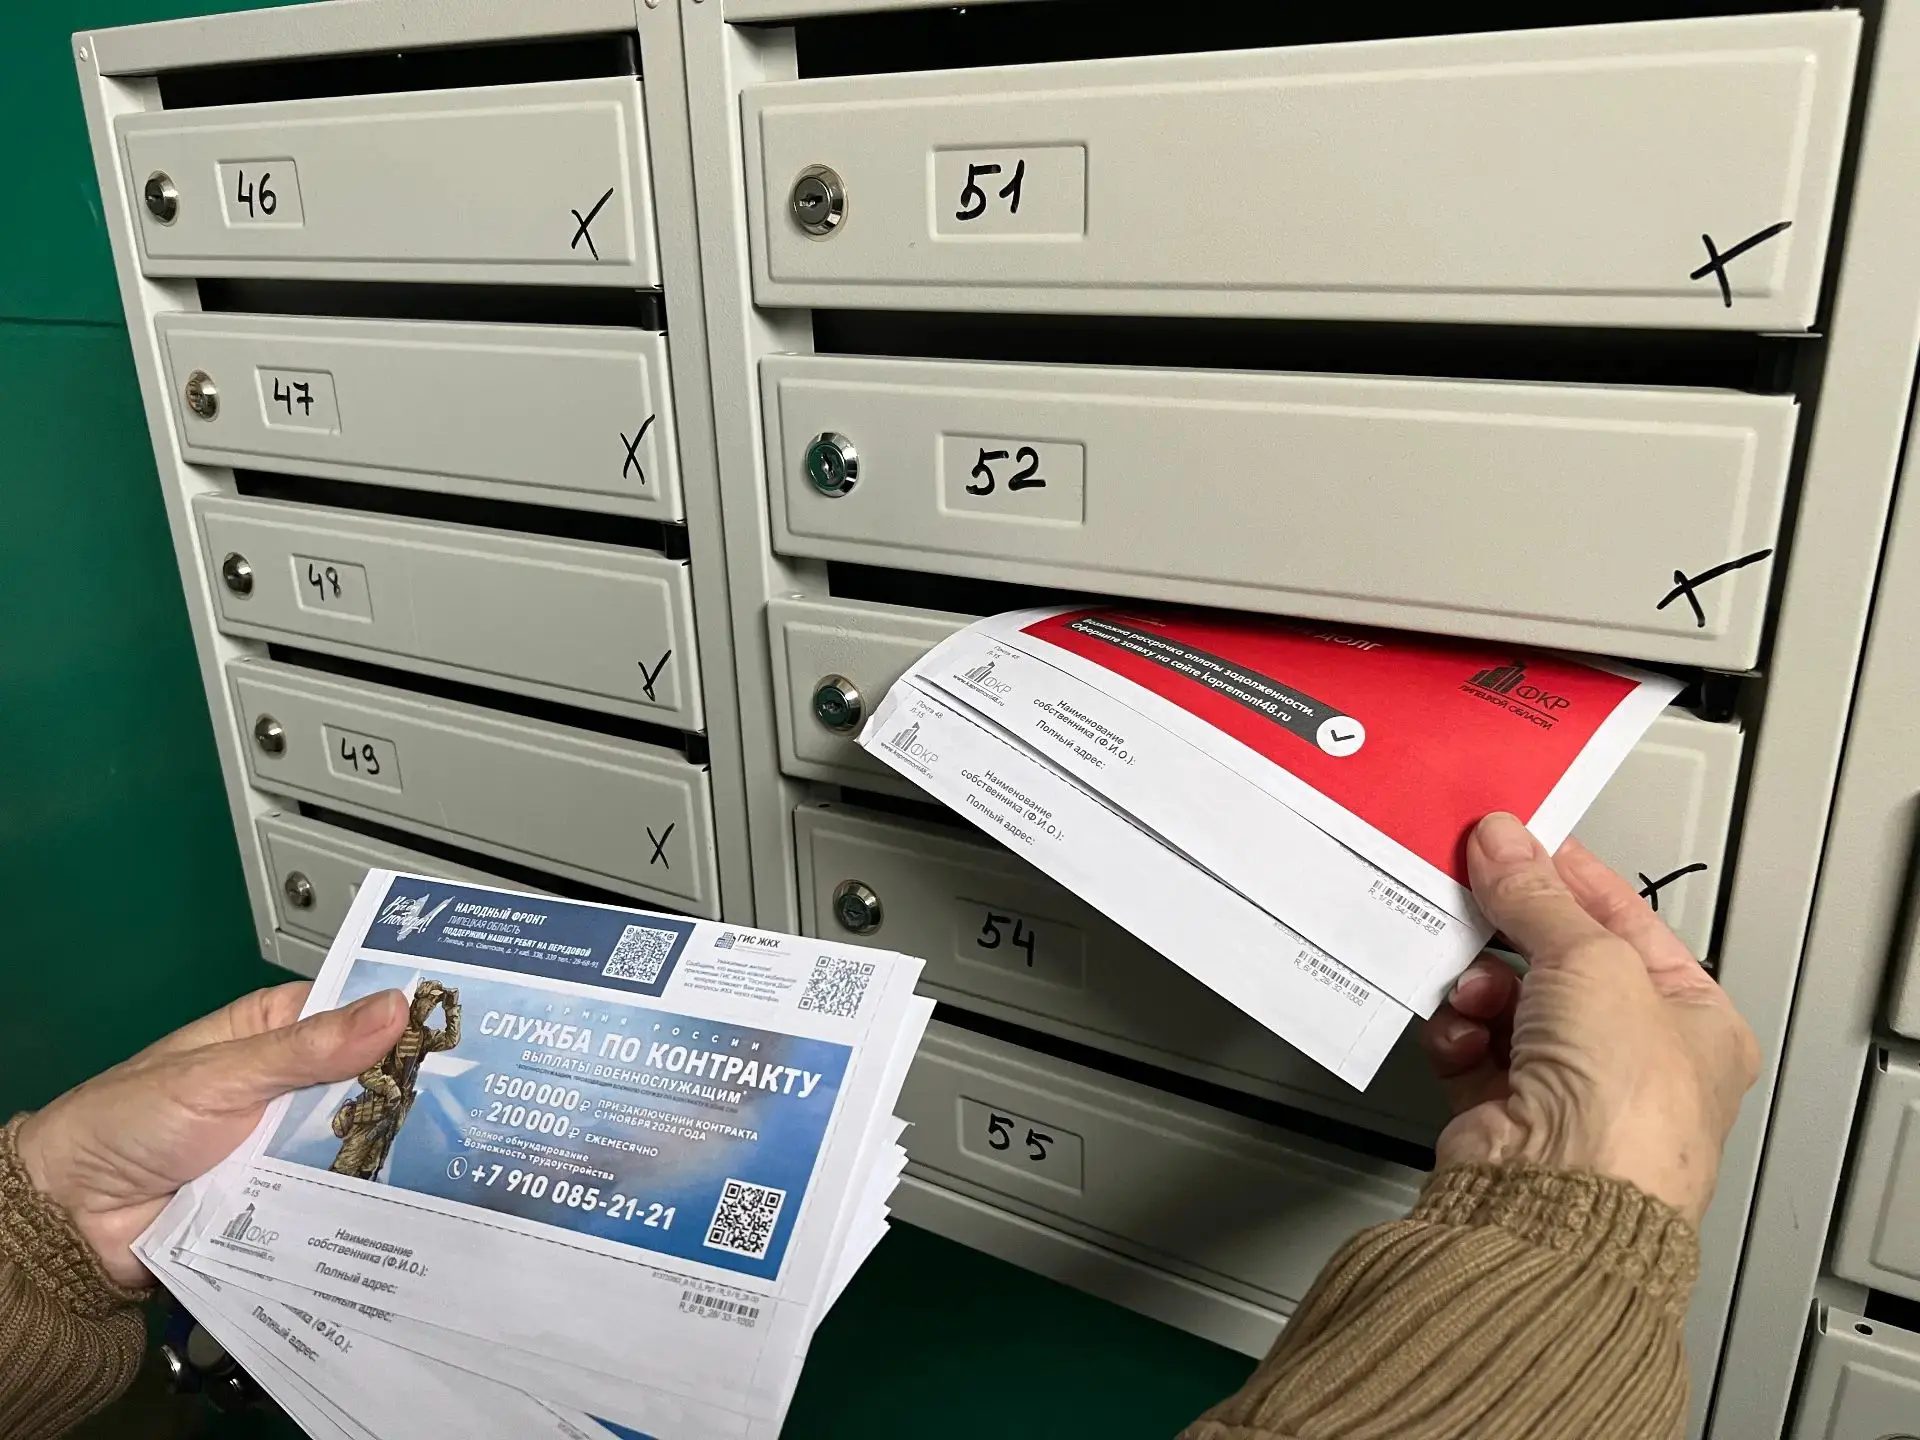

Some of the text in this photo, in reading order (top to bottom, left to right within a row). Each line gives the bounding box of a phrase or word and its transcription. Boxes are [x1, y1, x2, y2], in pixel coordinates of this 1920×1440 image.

[237, 170, 277, 217] 46
[955, 159, 1025, 221] 51
[274, 377, 314, 416] 47
[965, 446, 1046, 495] 52
[309, 564, 341, 601] 48
[983, 677, 1012, 694] ФКР
[1071, 622, 1292, 723] Оформите заявку на сайте kapremont48.ru
[1129, 632, 1183, 656] рассрочка
[1184, 651, 1224, 673] оплаты
[1223, 667, 1315, 717] задолженности.
[916, 700, 944, 719] Почта 48
[1458, 684, 1553, 730] ЛИПЕЦКОЙ ОБЛАСТИ
[1516, 685, 1571, 710] ФКР
[1033, 698, 1136, 766] собственника (Ф.И.О.):
[1057, 700, 1125, 745] Наименование
[341, 737, 380, 775] 49
[880, 742, 933, 780] www.kapremont48.ru
[911, 743, 939, 764] ФКР
[1036, 719, 1105, 769] Полный адрес:
[961, 768, 1065, 842] собственника (Ф.И.О.):
[984, 770, 1052, 819] Наименование
[966, 794, 1036, 846] Полный адрес:
[448, 916, 521, 935] ЛИПЕЦКАЯ ОБЛАСТЬ
[455, 902, 547, 926] НАРОДНЫЙ ФРОНТ
[443, 926, 592, 957] ПОДДЕРЖИМ НАШИХ РЕБЯТ НА ПЕРЕДОВОЙ
[737, 933, 780, 949] ГИС ЖКХ
[977, 912, 1035, 967] 54
[545, 1004, 760, 1051] АРМИЯ РОССИИ
[479, 1010, 822, 1099] СЛУЖБА ПО КОНТРАКТУ
[521, 1050, 592, 1073] ВЫПЛАТЫ
[598, 1099, 619, 1111] ПРИ
[620, 1103, 694, 1127] ЗАКЛЮЧЕНИИ
[695, 1120, 758, 1141] КОНТРАКТА
[608, 1112, 653, 1129] НОЯБРЯ
[652, 1122, 676, 1134] 2024
[678, 1127, 706, 1141] ГОДА
[988, 1113, 1053, 1161] 55
[464, 1138, 526, 1160] Возможность
[529, 1153, 615, 1180] трудоустройства
[468, 1127, 504, 1141] Полное
[505, 1136, 589, 1162] обмундирование
[584, 1132, 659, 1157] ЕЖЕМЕСЯЧНО
[471, 1164, 676, 1230] +7 910 085-21-21
[246, 1225, 279, 1246] ФКР
[335, 1227, 413, 1258] Наименование
[307, 1235, 429, 1277] собственника (Ф.И.О.):
[315, 1261, 399, 1295] Полный адрес:
[252, 1305, 291, 1340] Полный
